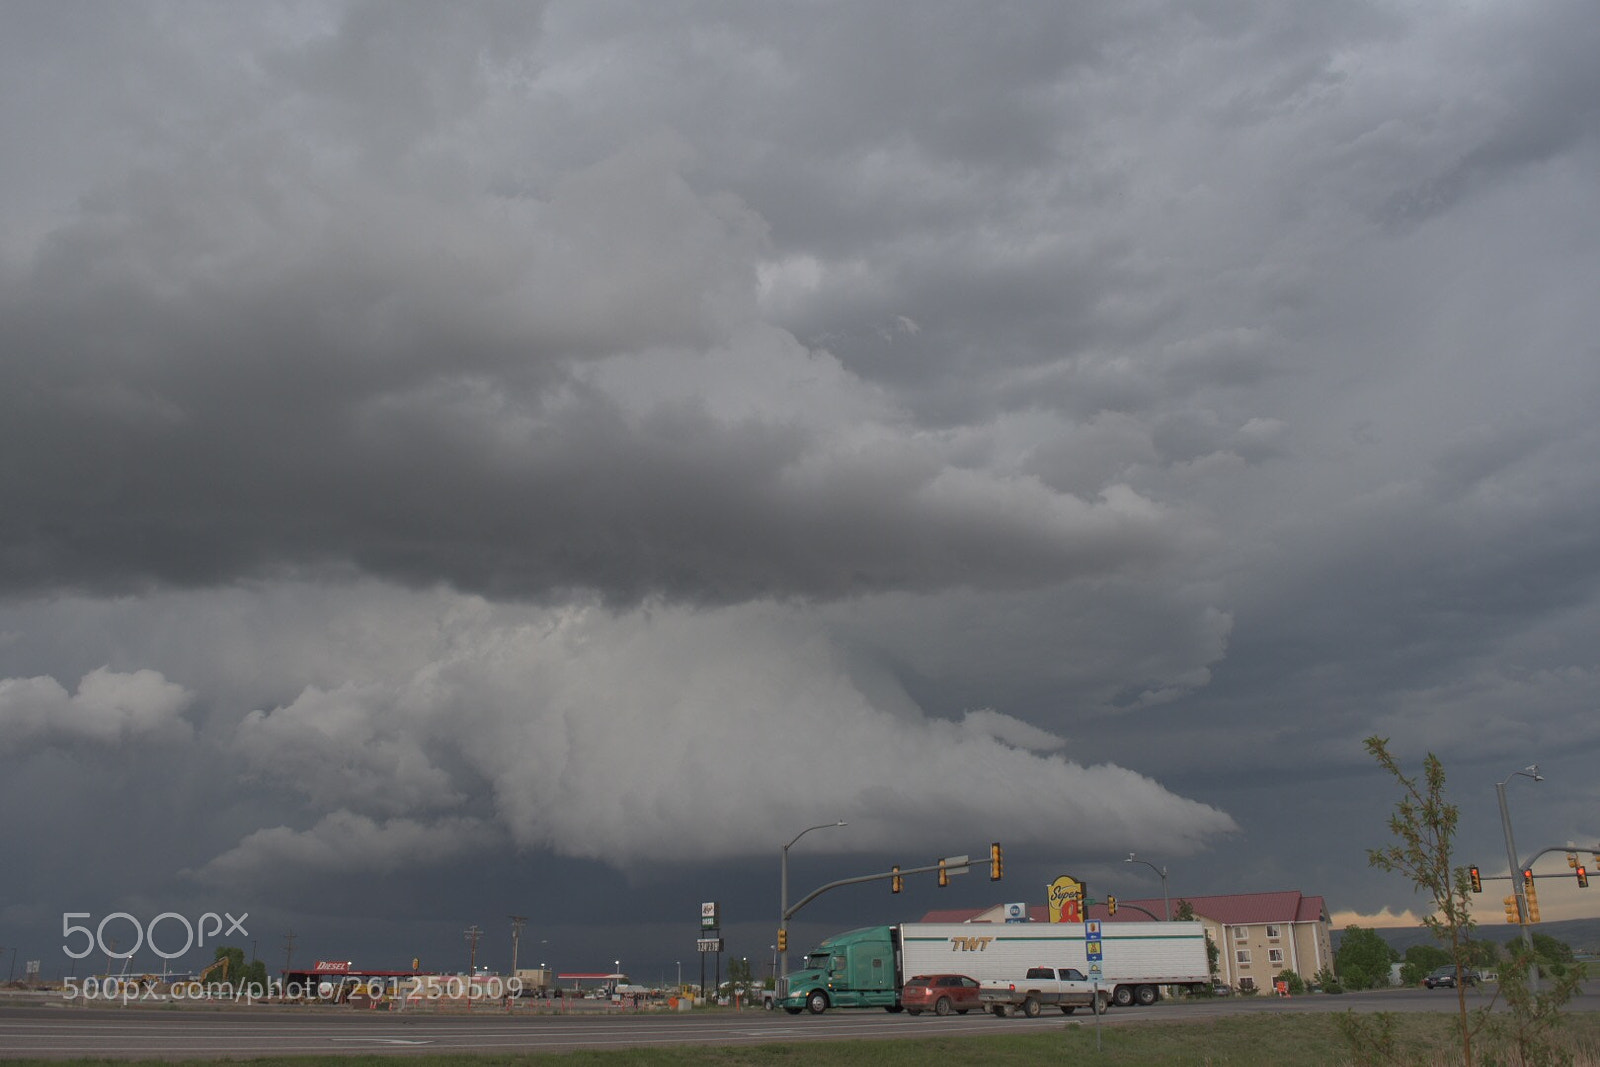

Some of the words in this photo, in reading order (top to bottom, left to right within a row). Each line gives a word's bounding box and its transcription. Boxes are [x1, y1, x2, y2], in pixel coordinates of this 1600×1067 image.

[1051, 885, 1081, 907] Super
[951, 936, 994, 951] TWT
[316, 961, 346, 970] DIESEL
